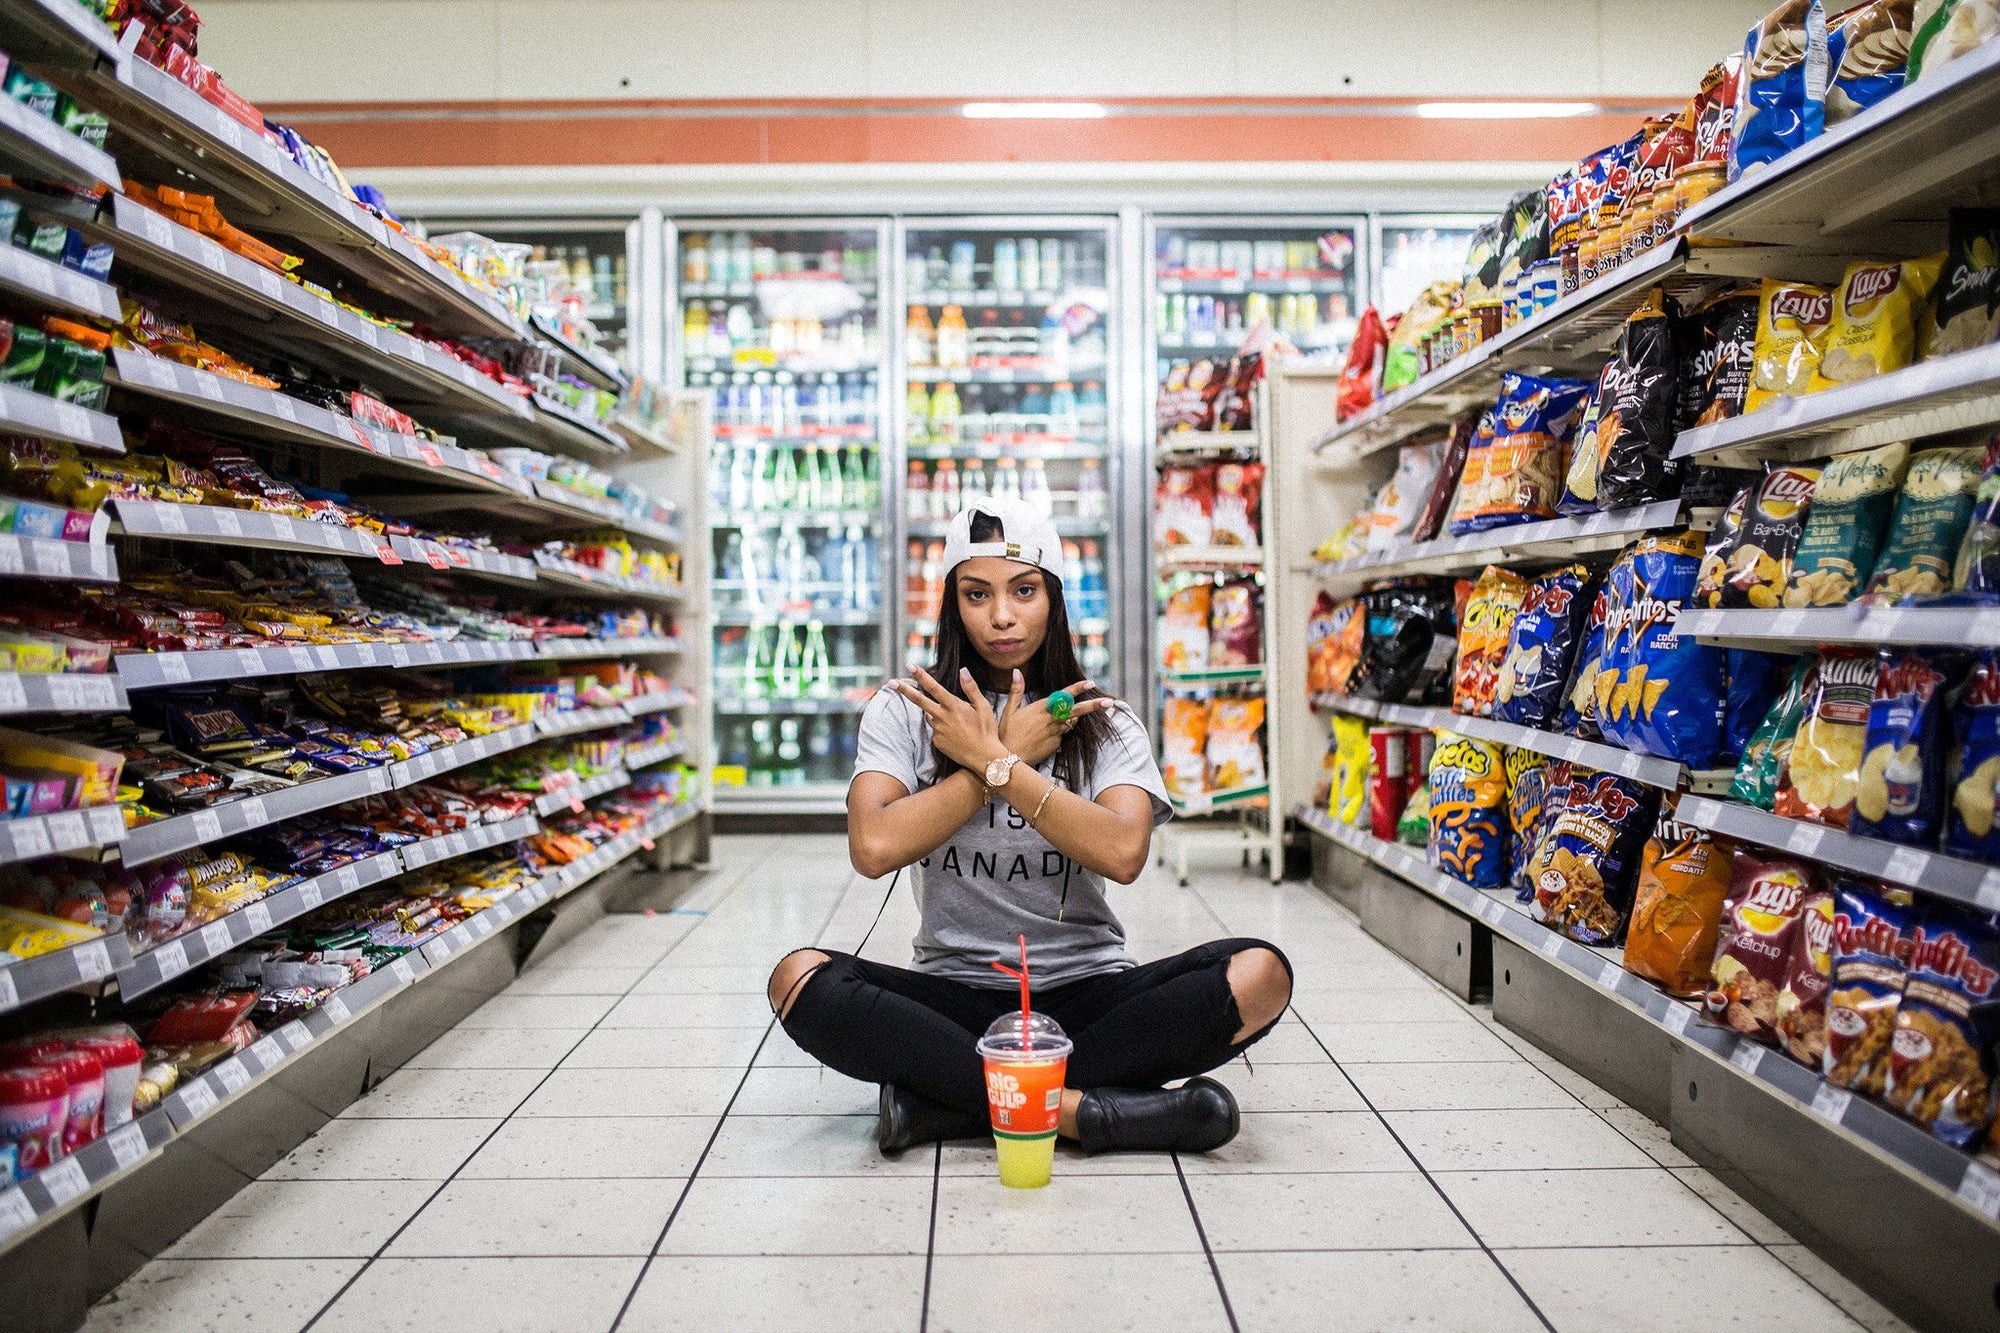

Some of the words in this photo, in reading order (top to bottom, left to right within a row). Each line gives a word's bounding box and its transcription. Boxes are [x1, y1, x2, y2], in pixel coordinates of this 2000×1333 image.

[1839, 455, 1888, 487] Vickie's
[1650, 641, 1678, 650] RANCH
[1657, 633, 1679, 642] COOL
[193, 710, 244, 738] CRUNCH
[1584, 828, 1608, 848] BACON
[1588, 816, 1611, 838] BACON
[193, 857, 238, 884] Mirage
[917, 845, 1084, 882] ANAD
[1733, 934, 1781, 959] Ketchup
[1834, 912, 1914, 960] Ruffle
[988, 1089, 1027, 1110] GULP
